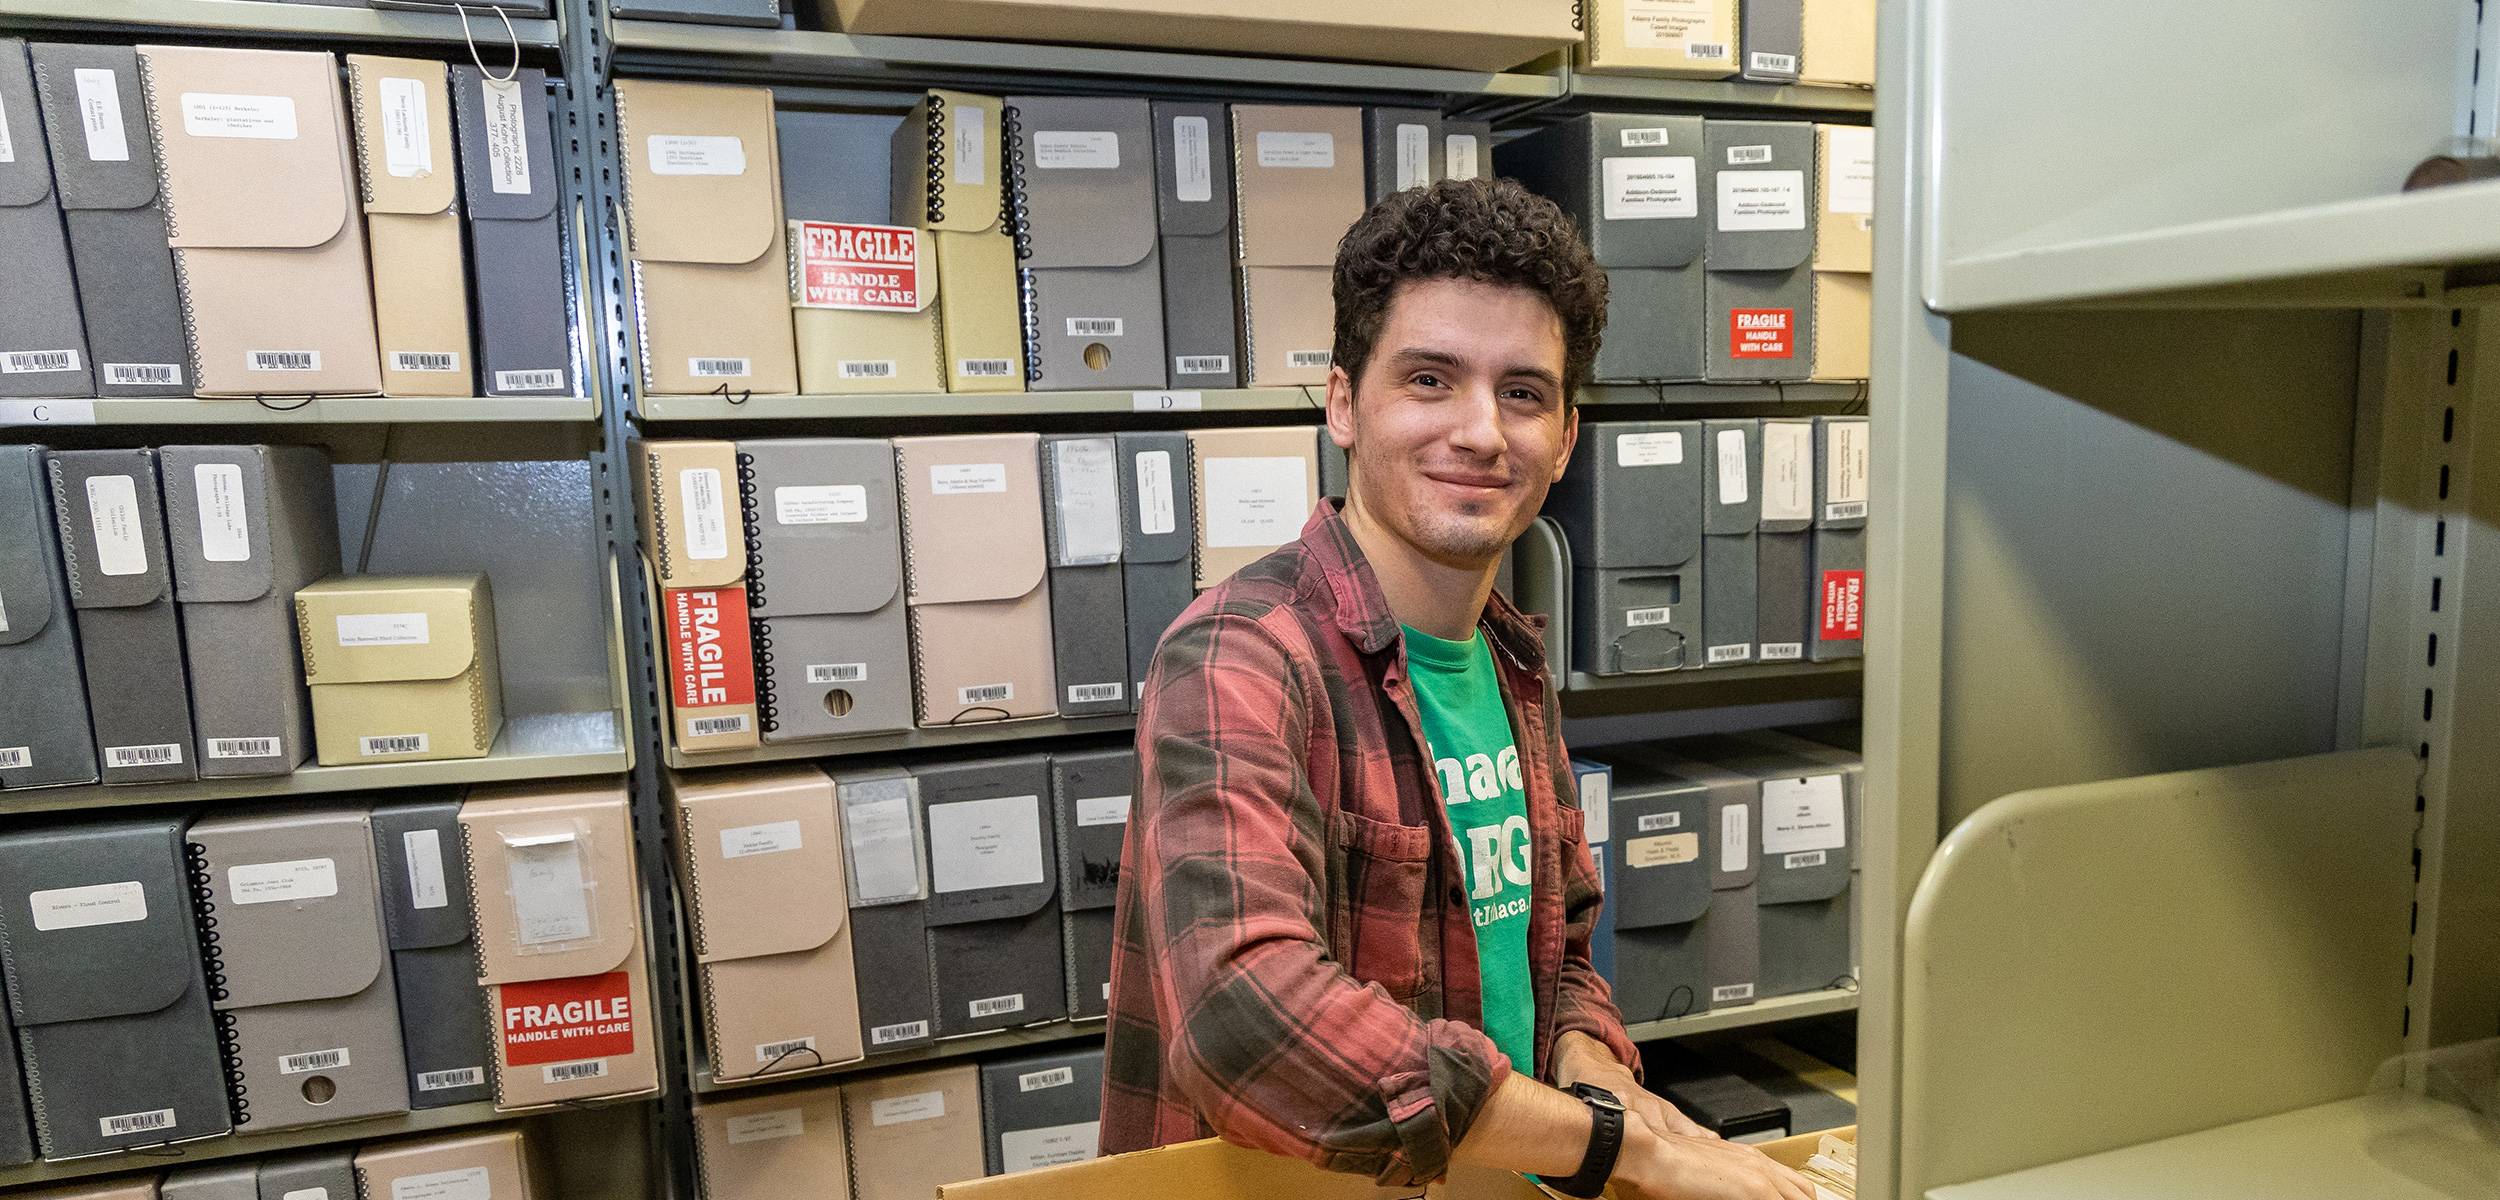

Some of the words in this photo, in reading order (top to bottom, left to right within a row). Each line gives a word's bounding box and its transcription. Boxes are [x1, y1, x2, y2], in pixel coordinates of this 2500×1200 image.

[497, 93, 507, 122] August
[501, 124, 510, 145] Kohn
[508, 104, 520, 154] Photographs
[514, 156, 523, 176] 2228
[502, 146, 513, 185] Collection
[804, 226, 914, 262] FRAGILE
[822, 271, 900, 287] HANDLE
[807, 286, 859, 303] WITH
[863, 289, 916, 304] CARE
[1737, 314, 1786, 328] FRAGILE
[1740, 343, 1760, 352] WITH
[1761, 343, 1783, 352] CARE
[1745, 331, 1777, 341] HANDLE
[33, 405, 50, 421] C
[1161, 396, 1173, 409] D
[1827, 580, 1836, 606] WITH
[1836, 586, 1845, 622] HANDLE
[1846, 577, 1860, 631] FRAGILE
[676, 592, 691, 639] HANDLE
[1826, 605, 1835, 629] CARE
[680, 640, 694, 672] WITH
[692, 592, 727, 703] FRAGILE
[684, 674, 699, 705] CARE
[505, 997, 629, 1030] FRAGILE
[507, 1029, 558, 1044] HANDLE
[561, 1026, 594, 1039] WITH
[597, 1022, 631, 1035] CARE
